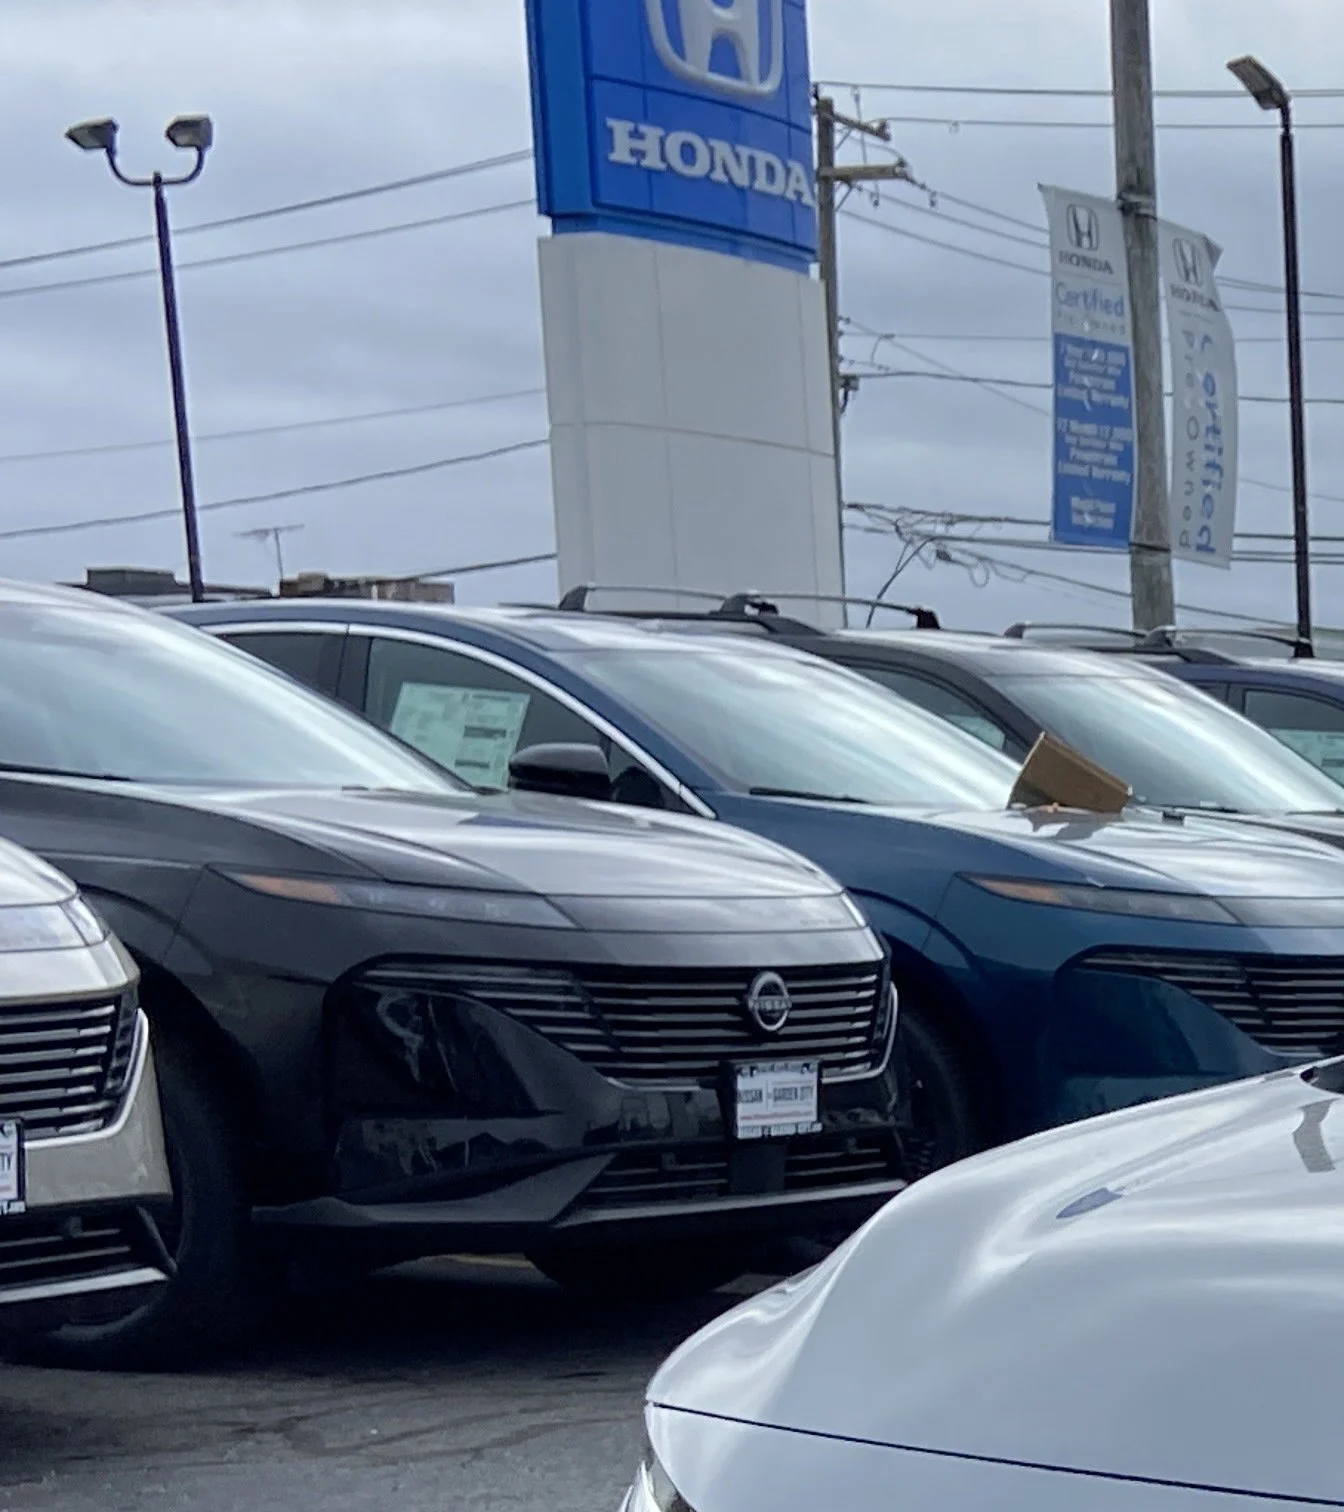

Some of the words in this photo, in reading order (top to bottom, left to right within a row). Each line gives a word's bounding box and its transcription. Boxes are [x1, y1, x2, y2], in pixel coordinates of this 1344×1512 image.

[606, 117, 819, 209] HONDA
[1058, 250, 1114, 275] HONDA
[1056, 281, 1126, 317] Certified
